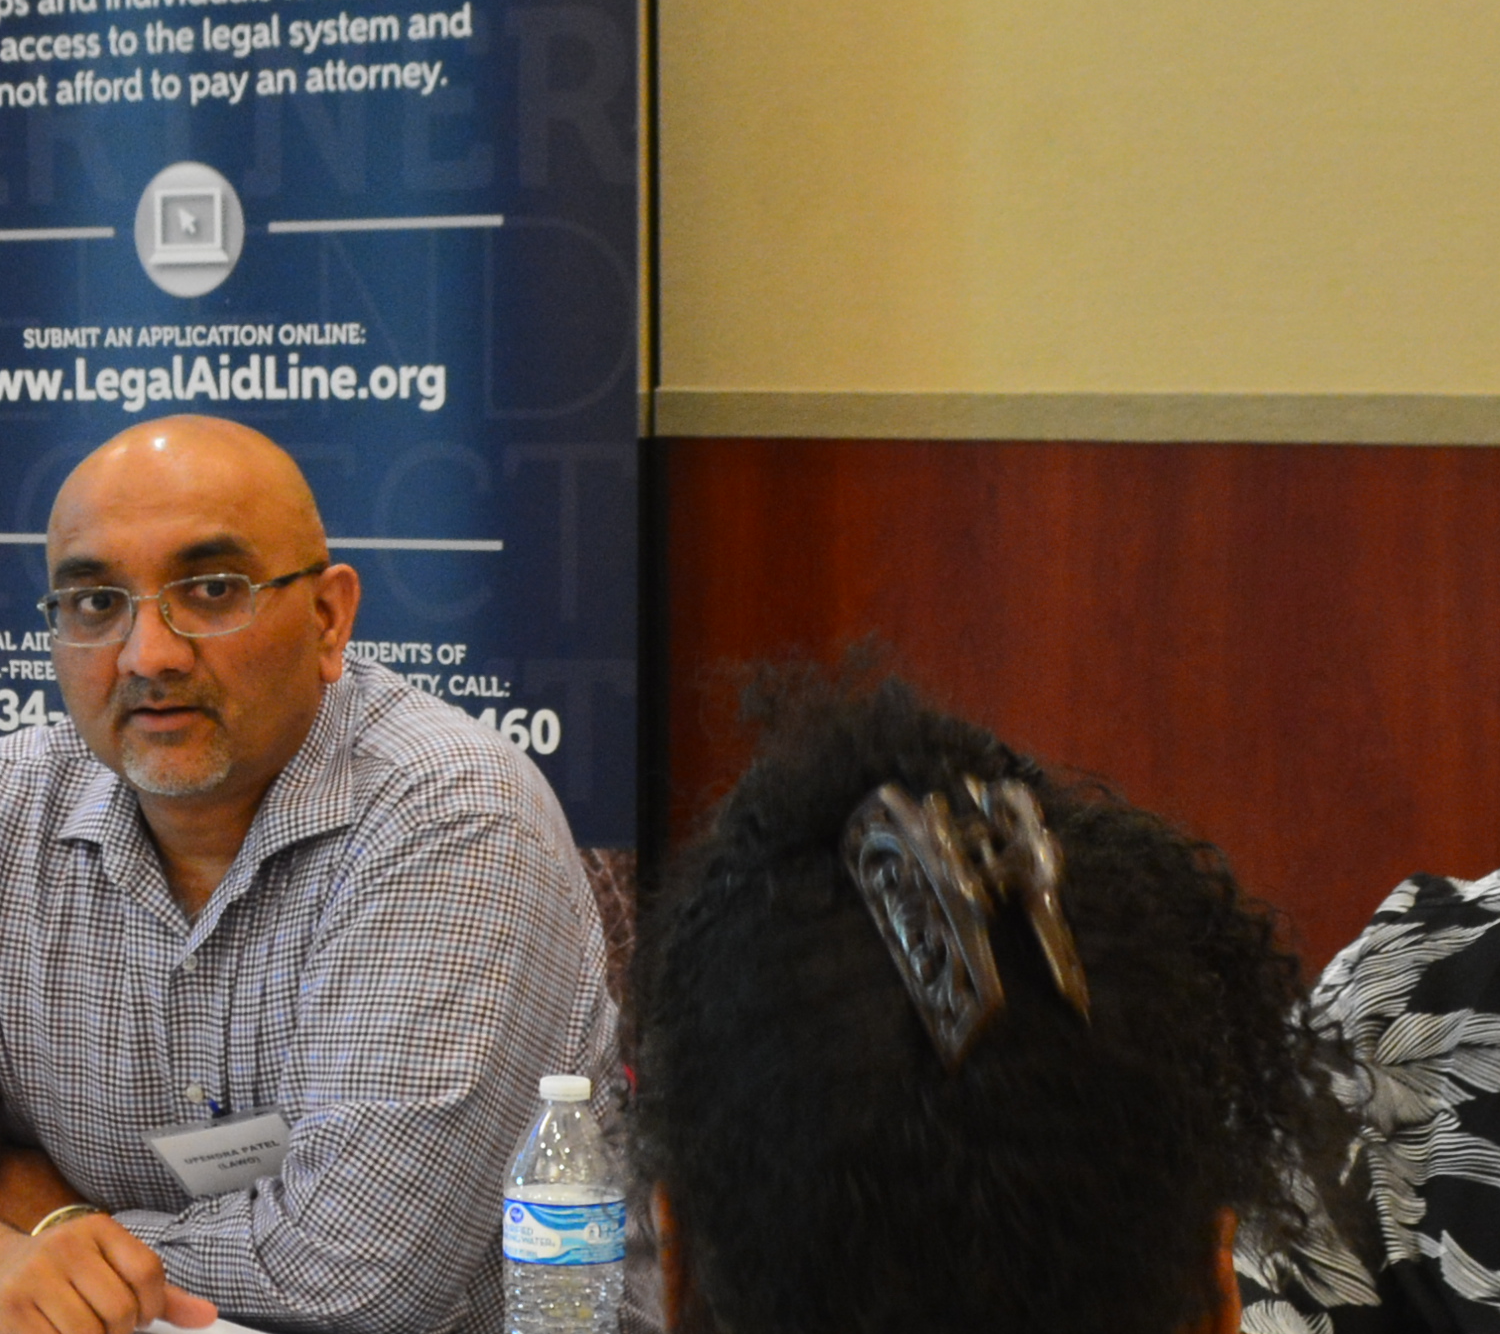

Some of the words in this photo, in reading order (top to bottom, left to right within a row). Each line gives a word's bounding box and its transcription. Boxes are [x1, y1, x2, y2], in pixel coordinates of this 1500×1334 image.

[0, 32, 101, 62] access
[108, 25, 138, 57] to
[145, 20, 195, 55] the
[203, 13, 280, 58] legal
[289, 11, 399, 54] system
[408, 1, 472, 40] and
[55, 67, 142, 105] afford
[150, 68, 181, 100] to
[189, 70, 248, 106] pay
[256, 68, 297, 96] an
[304, 59, 448, 96] attorney.
[23, 328, 100, 349] SUBMIT
[104, 327, 133, 348] AN
[137, 325, 272, 348] APPLICATION
[278, 323, 366, 346] ONLINE:
[344, 641, 432, 664] SIDENTS
[437, 644, 466, 665] OF
[448, 675, 510, 697] CALL:
[184, 1150, 239, 1164] UPENDRA
[241, 1140, 280, 1153] PATEL
